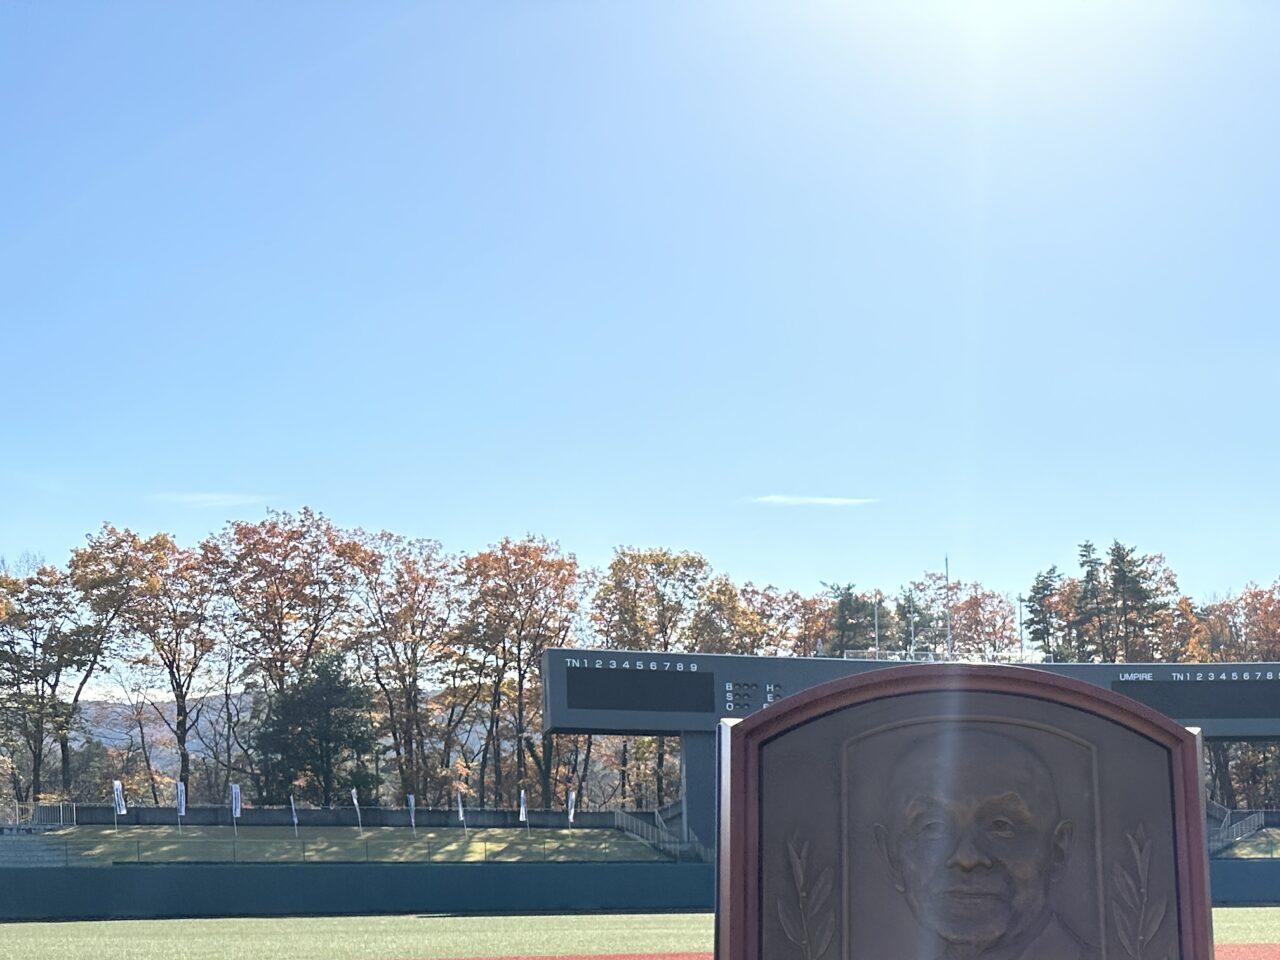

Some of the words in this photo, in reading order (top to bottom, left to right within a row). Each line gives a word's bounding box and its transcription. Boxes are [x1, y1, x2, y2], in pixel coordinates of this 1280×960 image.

[565, 658, 580, 668] TN
[583, 659, 589, 668] 1
[595, 659, 603, 668] 2
[609, 660, 617, 669] 3
[622, 660, 630, 669] 4
[636, 661, 644, 670] 5
[649, 661, 657, 670] 6
[663, 662, 671, 671] 7
[676, 663, 684, 671] 8
[690, 663, 698, 672] 9
[1119, 672, 1153, 681] UMPIRE
[1172, 672, 1184, 681] TN
[1255, 672, 1262, 680] 7
[1266, 672, 1273, 680] 8
[725, 682, 733, 691] B
[766, 683, 774, 692] H
[726, 692, 733, 701] S
[767, 693, 774, 702] E
